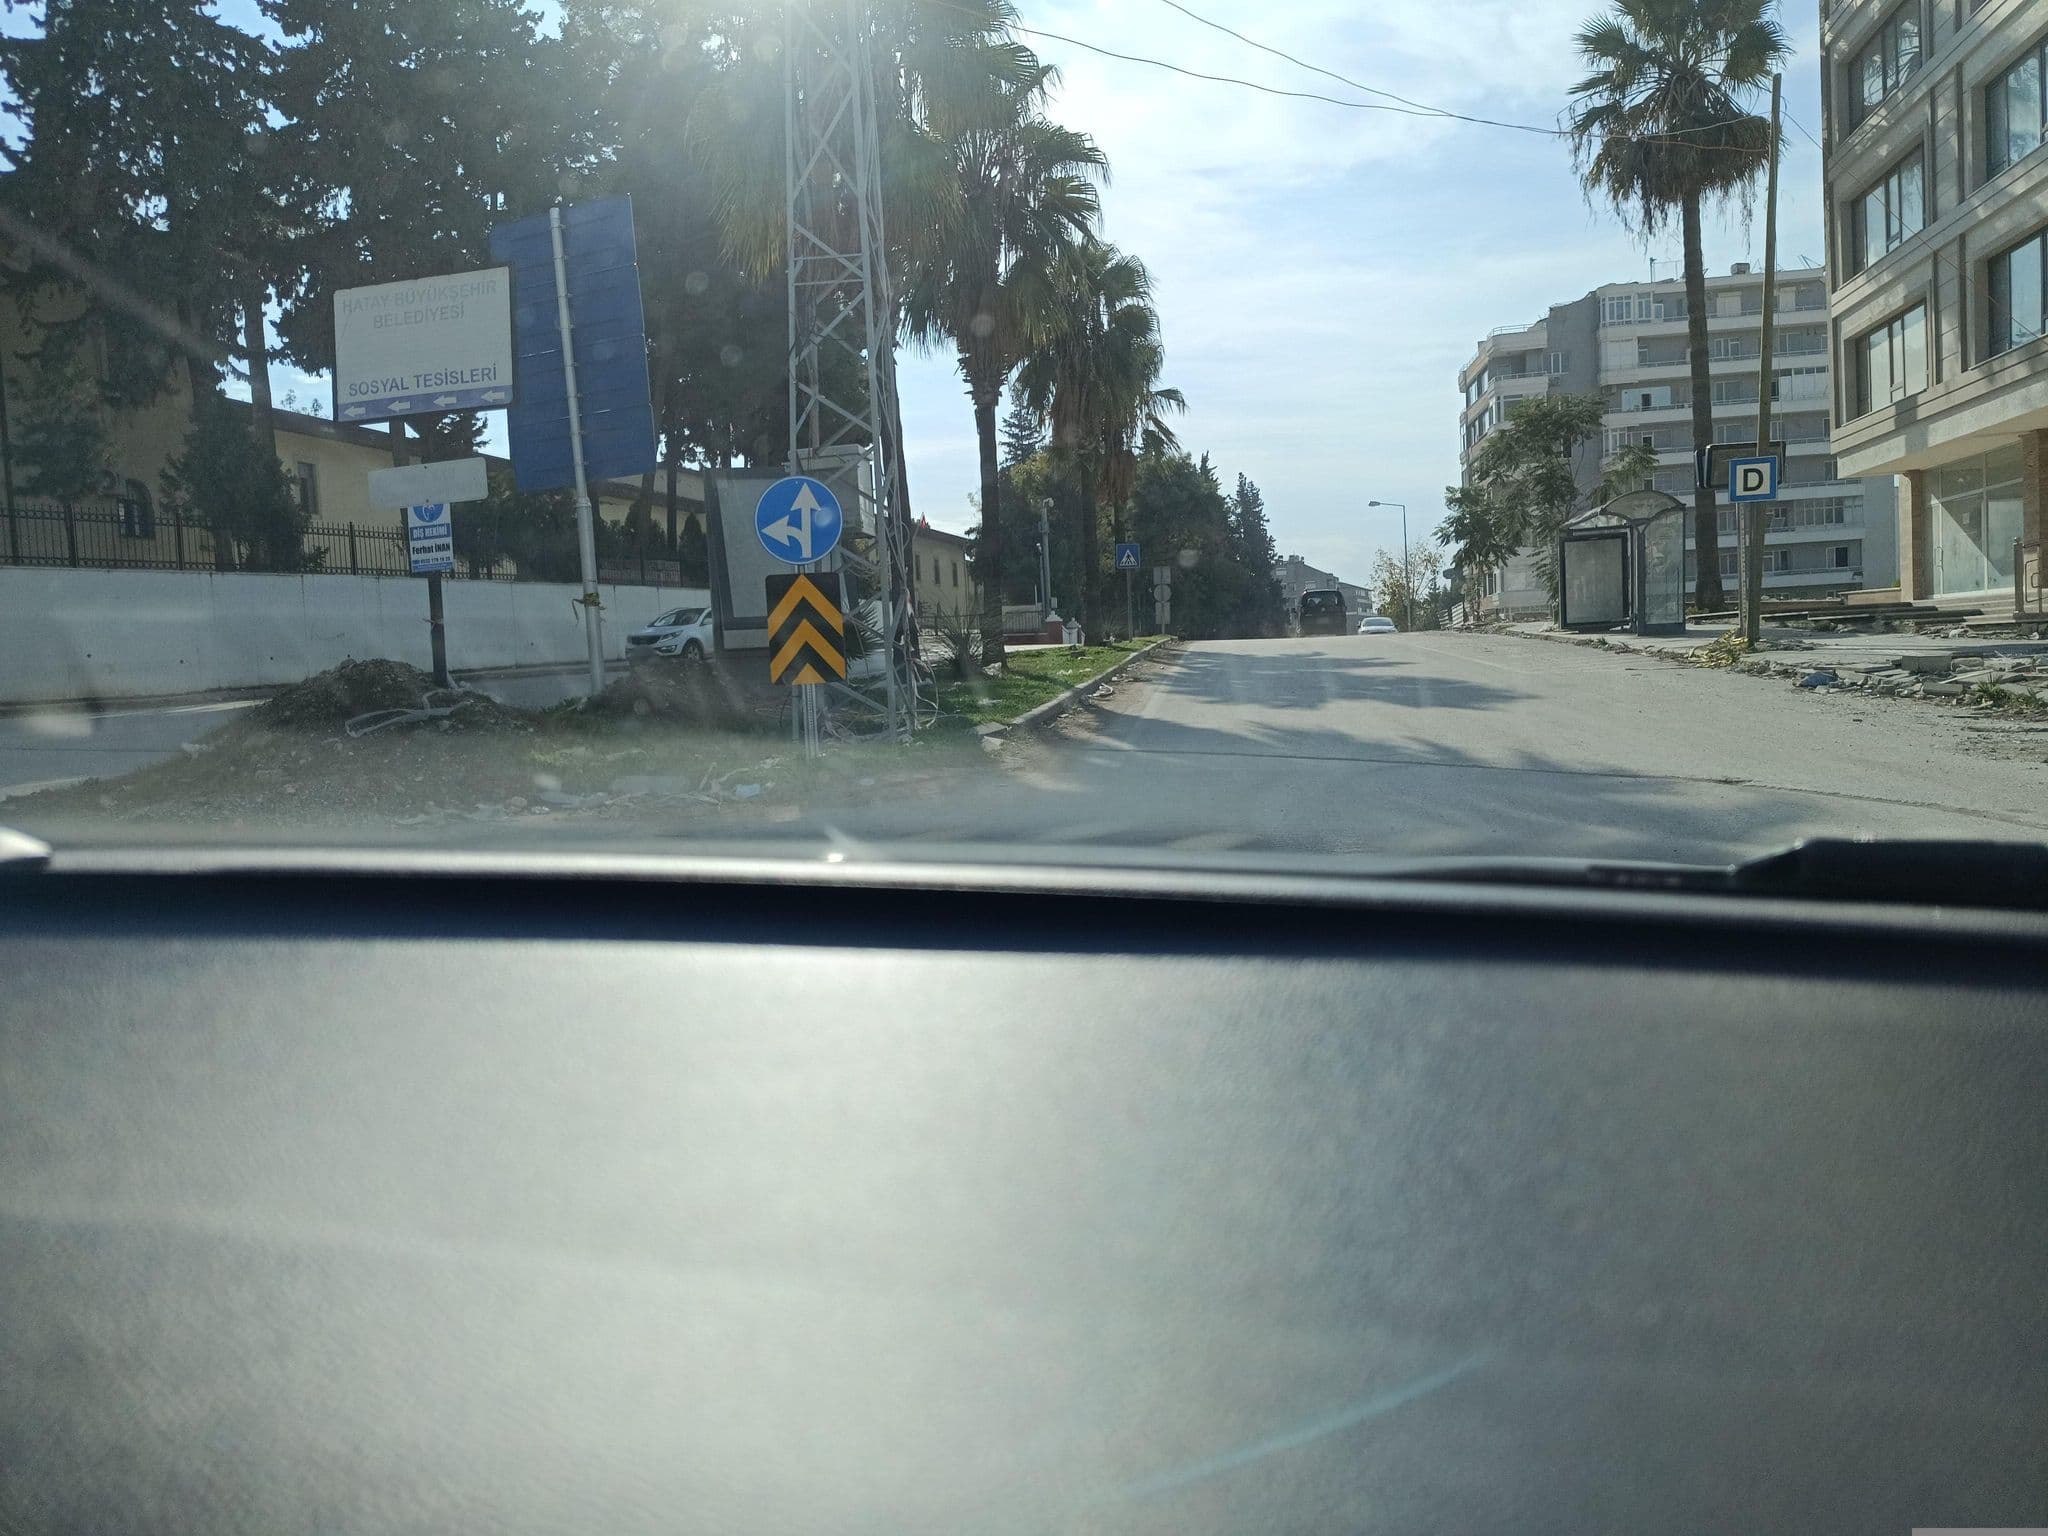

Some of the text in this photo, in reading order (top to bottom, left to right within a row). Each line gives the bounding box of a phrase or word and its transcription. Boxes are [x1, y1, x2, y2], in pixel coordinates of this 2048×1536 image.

[374, 300, 465, 329] BELEDİYESİ
[348, 362, 497, 397] SOSYAL TESİSLERİ
[1742, 468, 1764, 492] D
